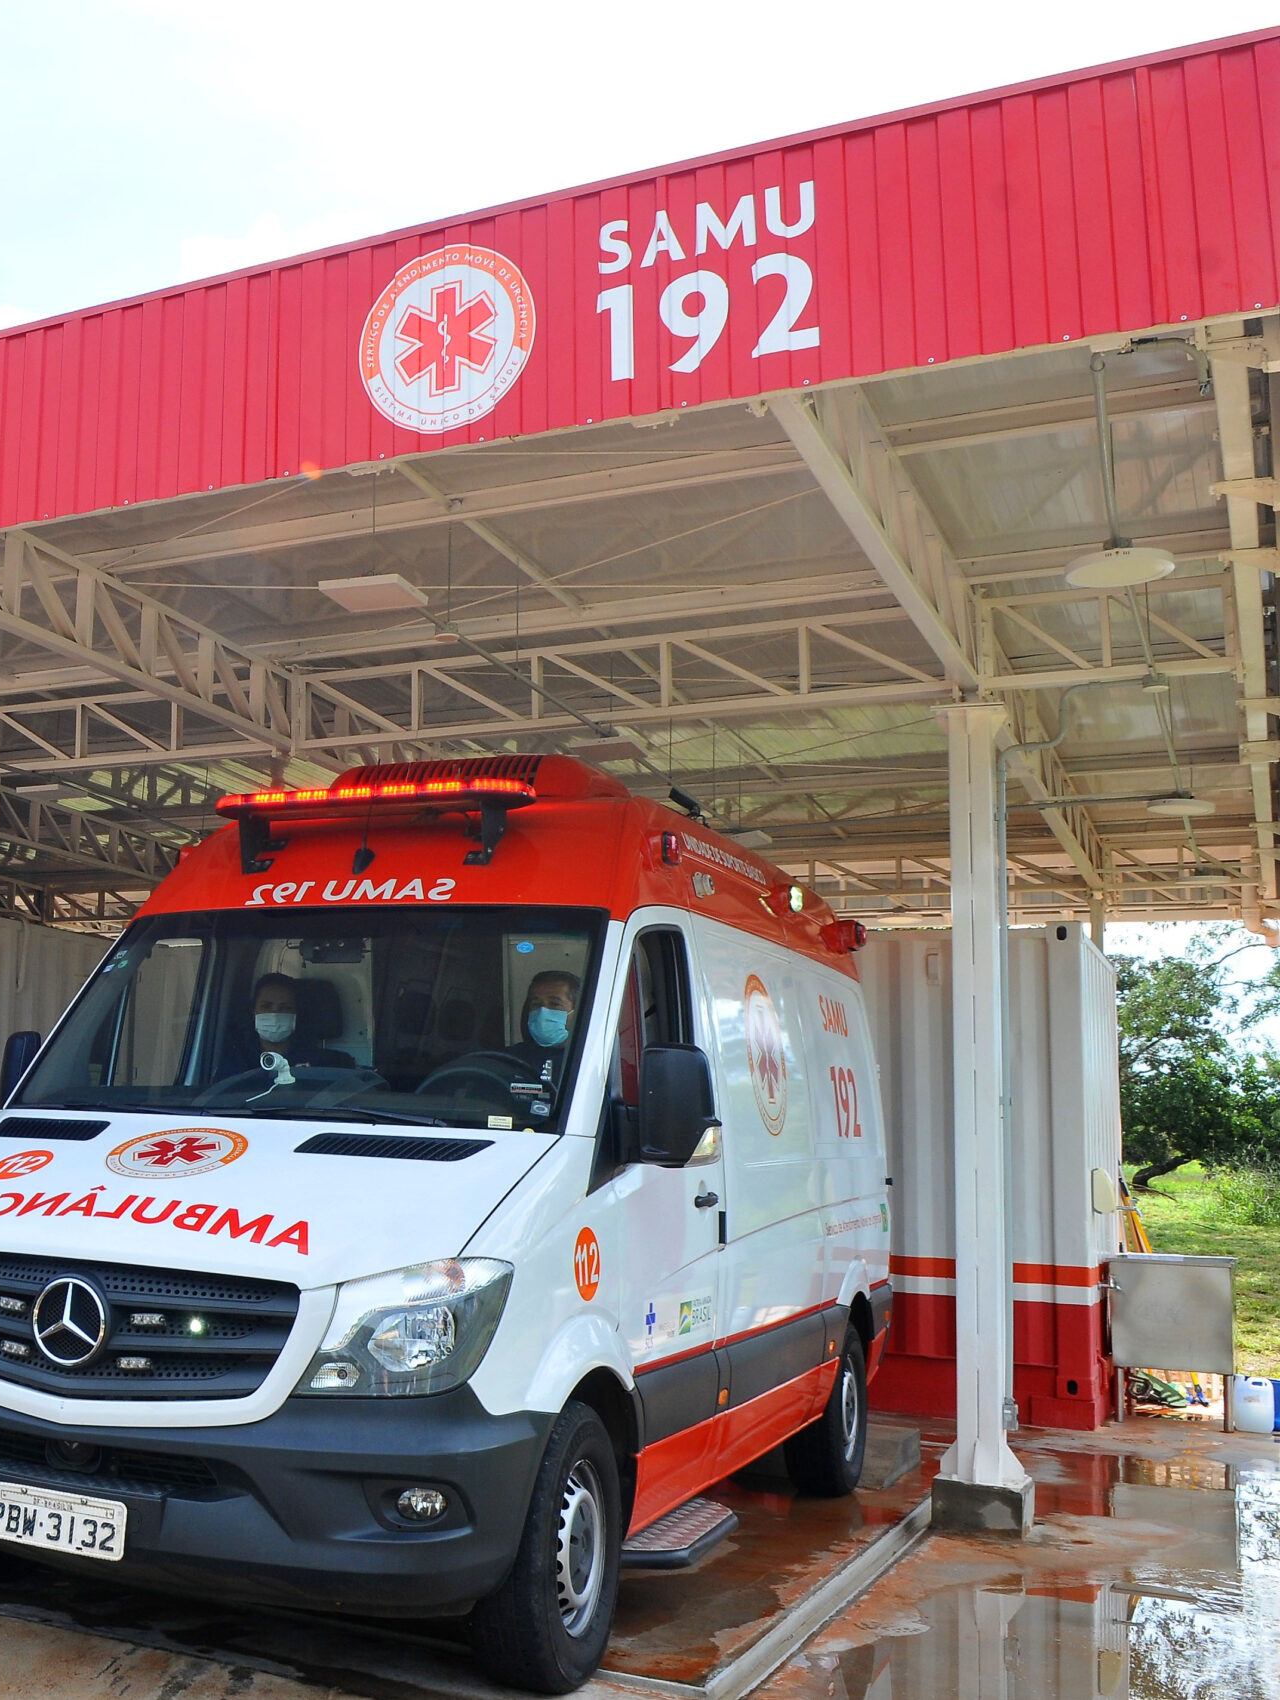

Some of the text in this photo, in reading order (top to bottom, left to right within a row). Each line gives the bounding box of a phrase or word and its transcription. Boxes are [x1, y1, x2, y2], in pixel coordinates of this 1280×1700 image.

[598, 180, 815, 274] SAMU
[367, 252, 528, 367] SERVIÇO DE AENDIMENTO MÓVE DE URGÊNCIA
[596, 253, 820, 381] 192
[375, 386, 412, 421] SISTMA
[468, 403, 484, 416] DE
[490, 360, 518, 401] SAÚDE
[819, 995, 848, 1037] SAMU
[830, 1066, 861, 1138] 192
[575, 1242, 599, 1287] 112
